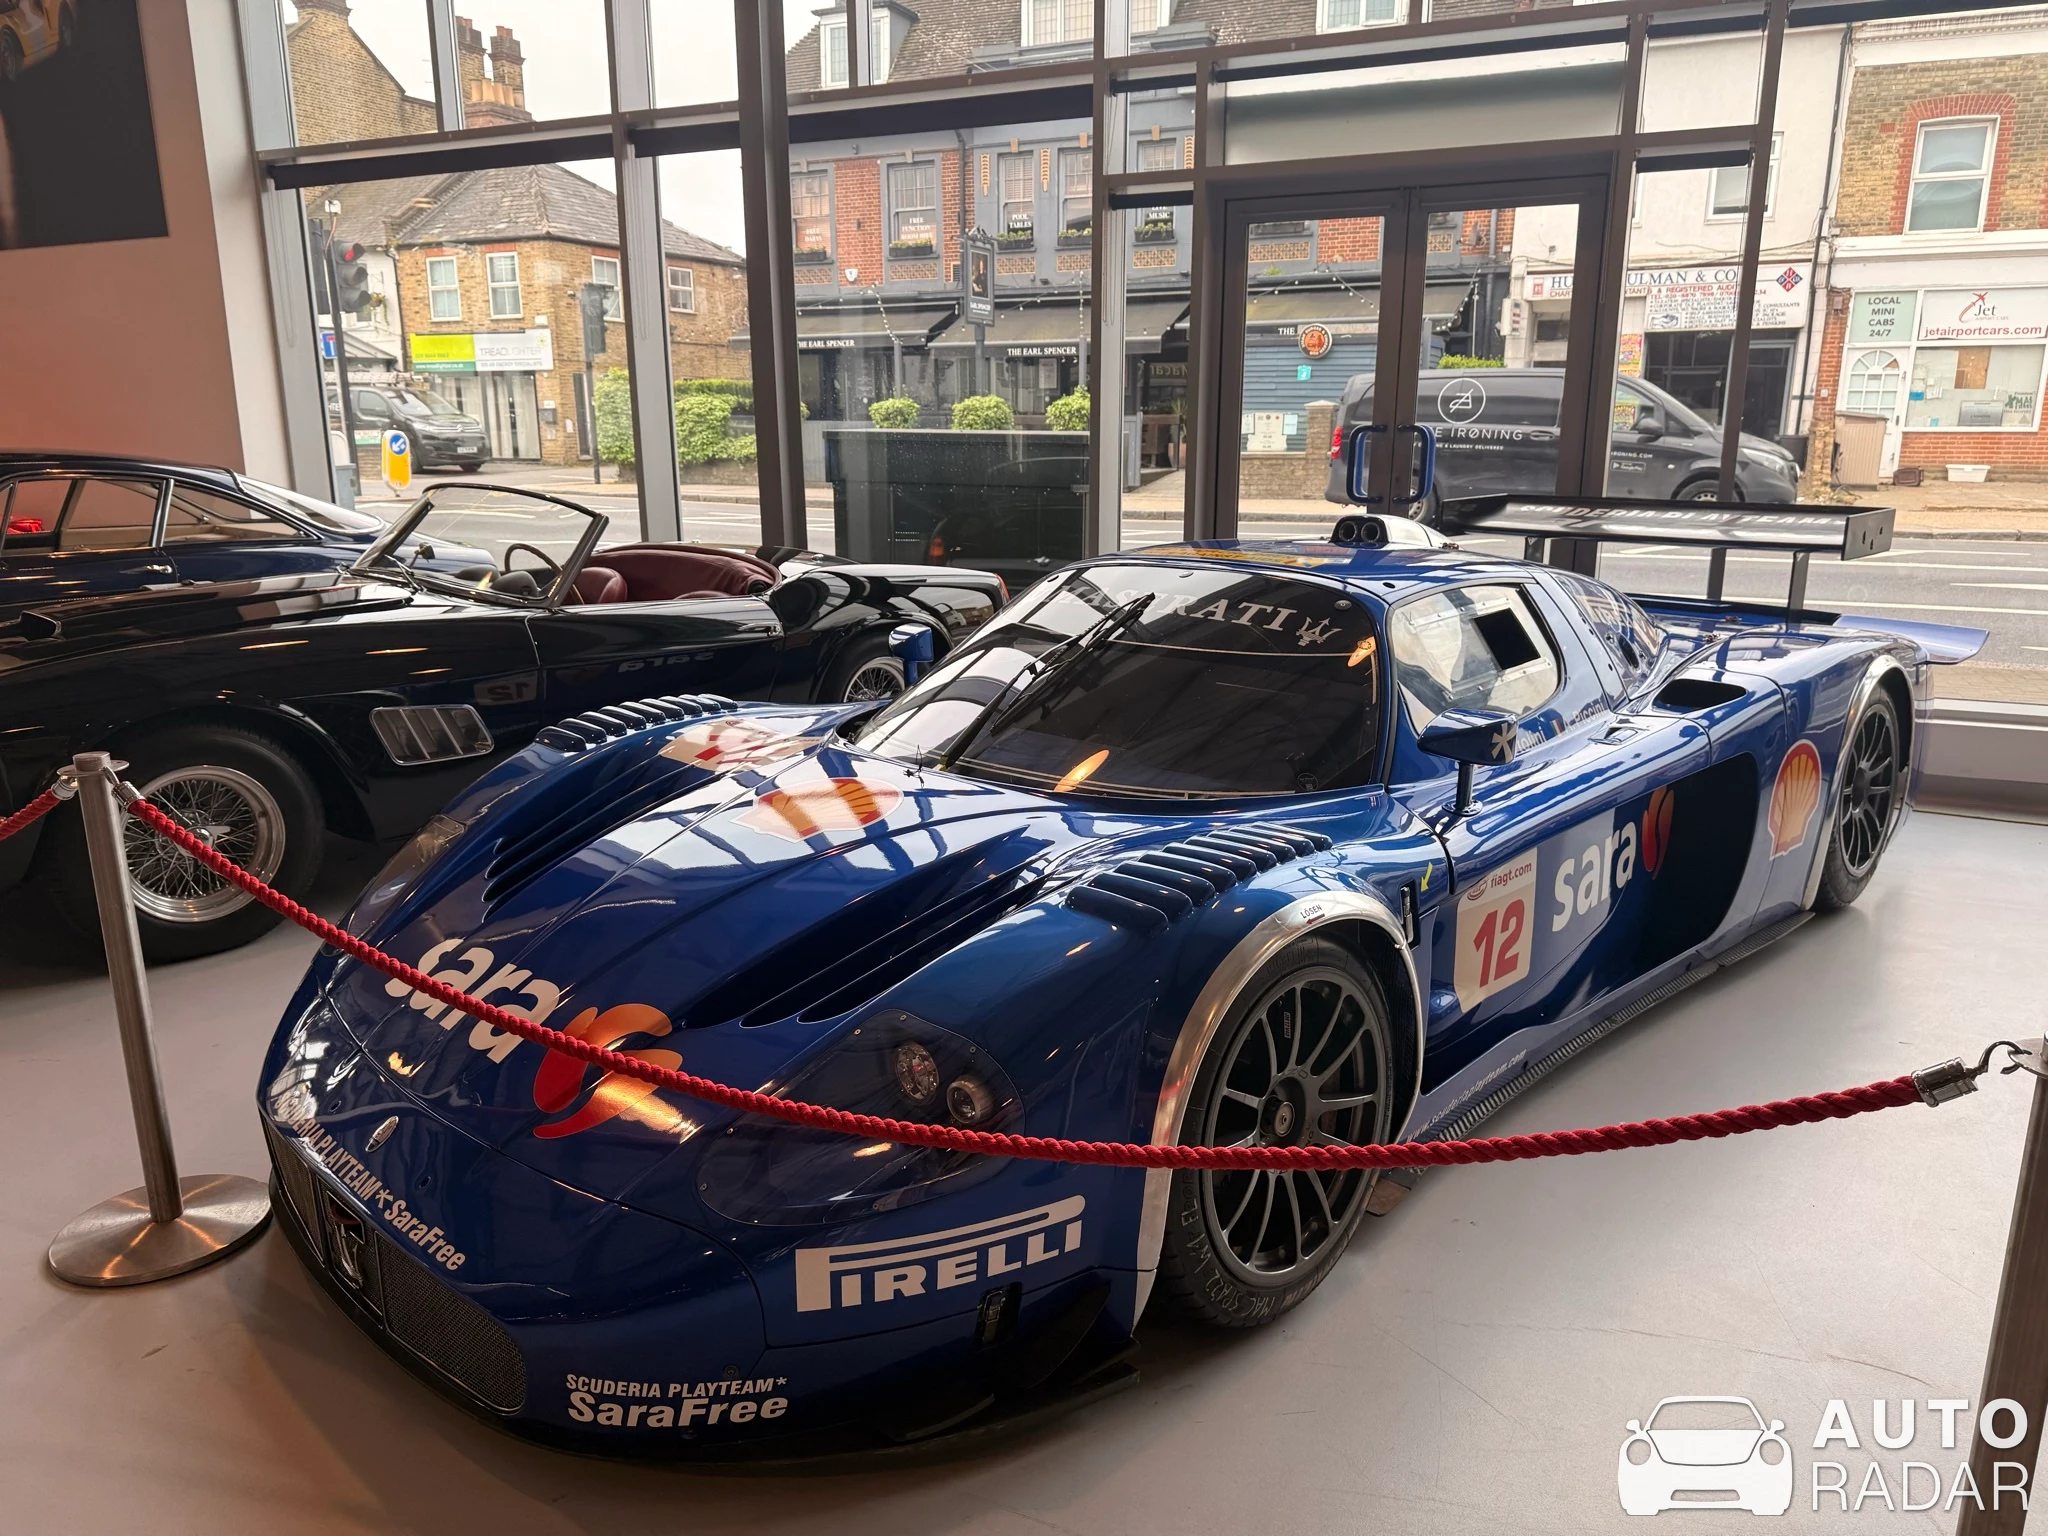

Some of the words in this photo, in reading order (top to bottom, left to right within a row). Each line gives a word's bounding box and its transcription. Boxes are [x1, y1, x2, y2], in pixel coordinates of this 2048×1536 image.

[1148, 211, 1170, 219] MUSIC
[1009, 221, 1032, 229] TABLES
[1552, 276, 1574, 288] HU
[1626, 270, 1688, 286] ULMAN
[1695, 269, 1706, 283] &
[1666, 284, 1714, 293] REGISTERED
[1717, 283, 1736, 291] AUDI
[1868, 296, 1901, 306] LOCAL
[1871, 308, 1895, 316] MINI
[1973, 304, 1997, 317] Jet
[1868, 318, 1895, 327] CABS
[1278, 327, 1296, 336] THE
[1869, 329, 1892, 338] 24/7
[1924, 325, 2042, 339] jetairportcars.com
[808, 340, 826, 348] EARL
[826, 339, 855, 348] SPENCER
[480, 346, 541, 357] TREADLIGHTER
[1007, 347, 1022, 356] THE
[1023, 347, 1042, 355] EARL
[1043, 346, 1077, 355] SPENCER
[1610, 451, 1653, 459] IRONING.COM
[1490, 862, 1532, 889] fiagt.com
[1552, 821, 1637, 932] sara
[1300, 904, 1323, 919] LÖSEN
[1473, 898, 1525, 989] 12
[384, 938, 560, 1064] sara
[273, 1092, 323, 1148] SCUDERIA
[384, 1200, 466, 1271] SaraFree
[796, 1195, 1086, 1313] PIRELLI
[565, 1373, 661, 1398] SCUDERIA
[567, 1391, 789, 1428] SaraFree
